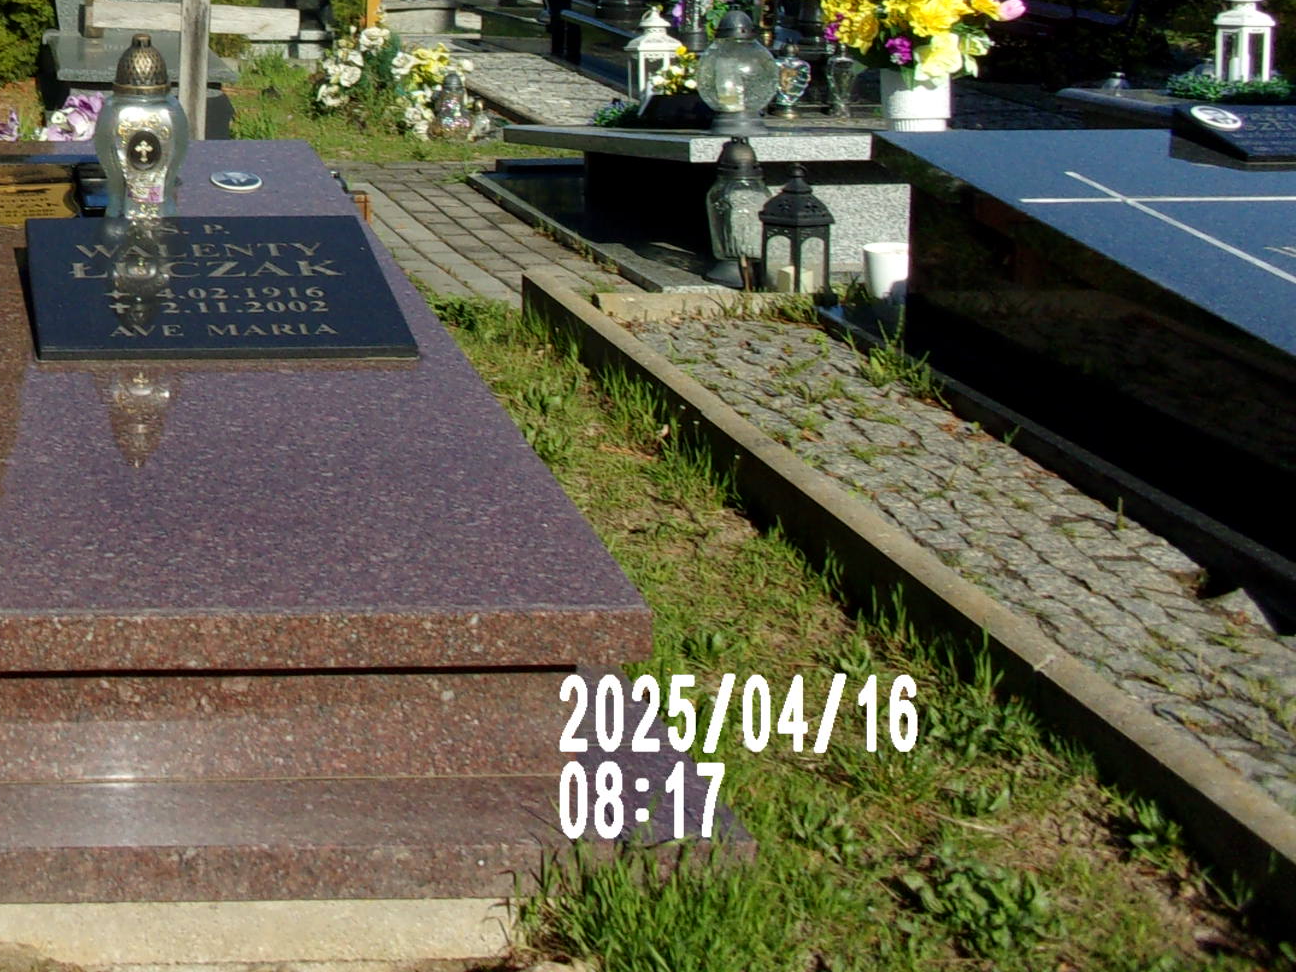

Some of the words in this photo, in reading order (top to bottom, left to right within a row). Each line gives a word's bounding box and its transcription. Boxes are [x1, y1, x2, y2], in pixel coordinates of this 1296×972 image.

[75, 242, 321, 259] WALENTY
[68, 259, 345, 279] ŁUCZAK
[109, 324, 184, 337] AVE
[207, 323, 339, 337] MARIA
